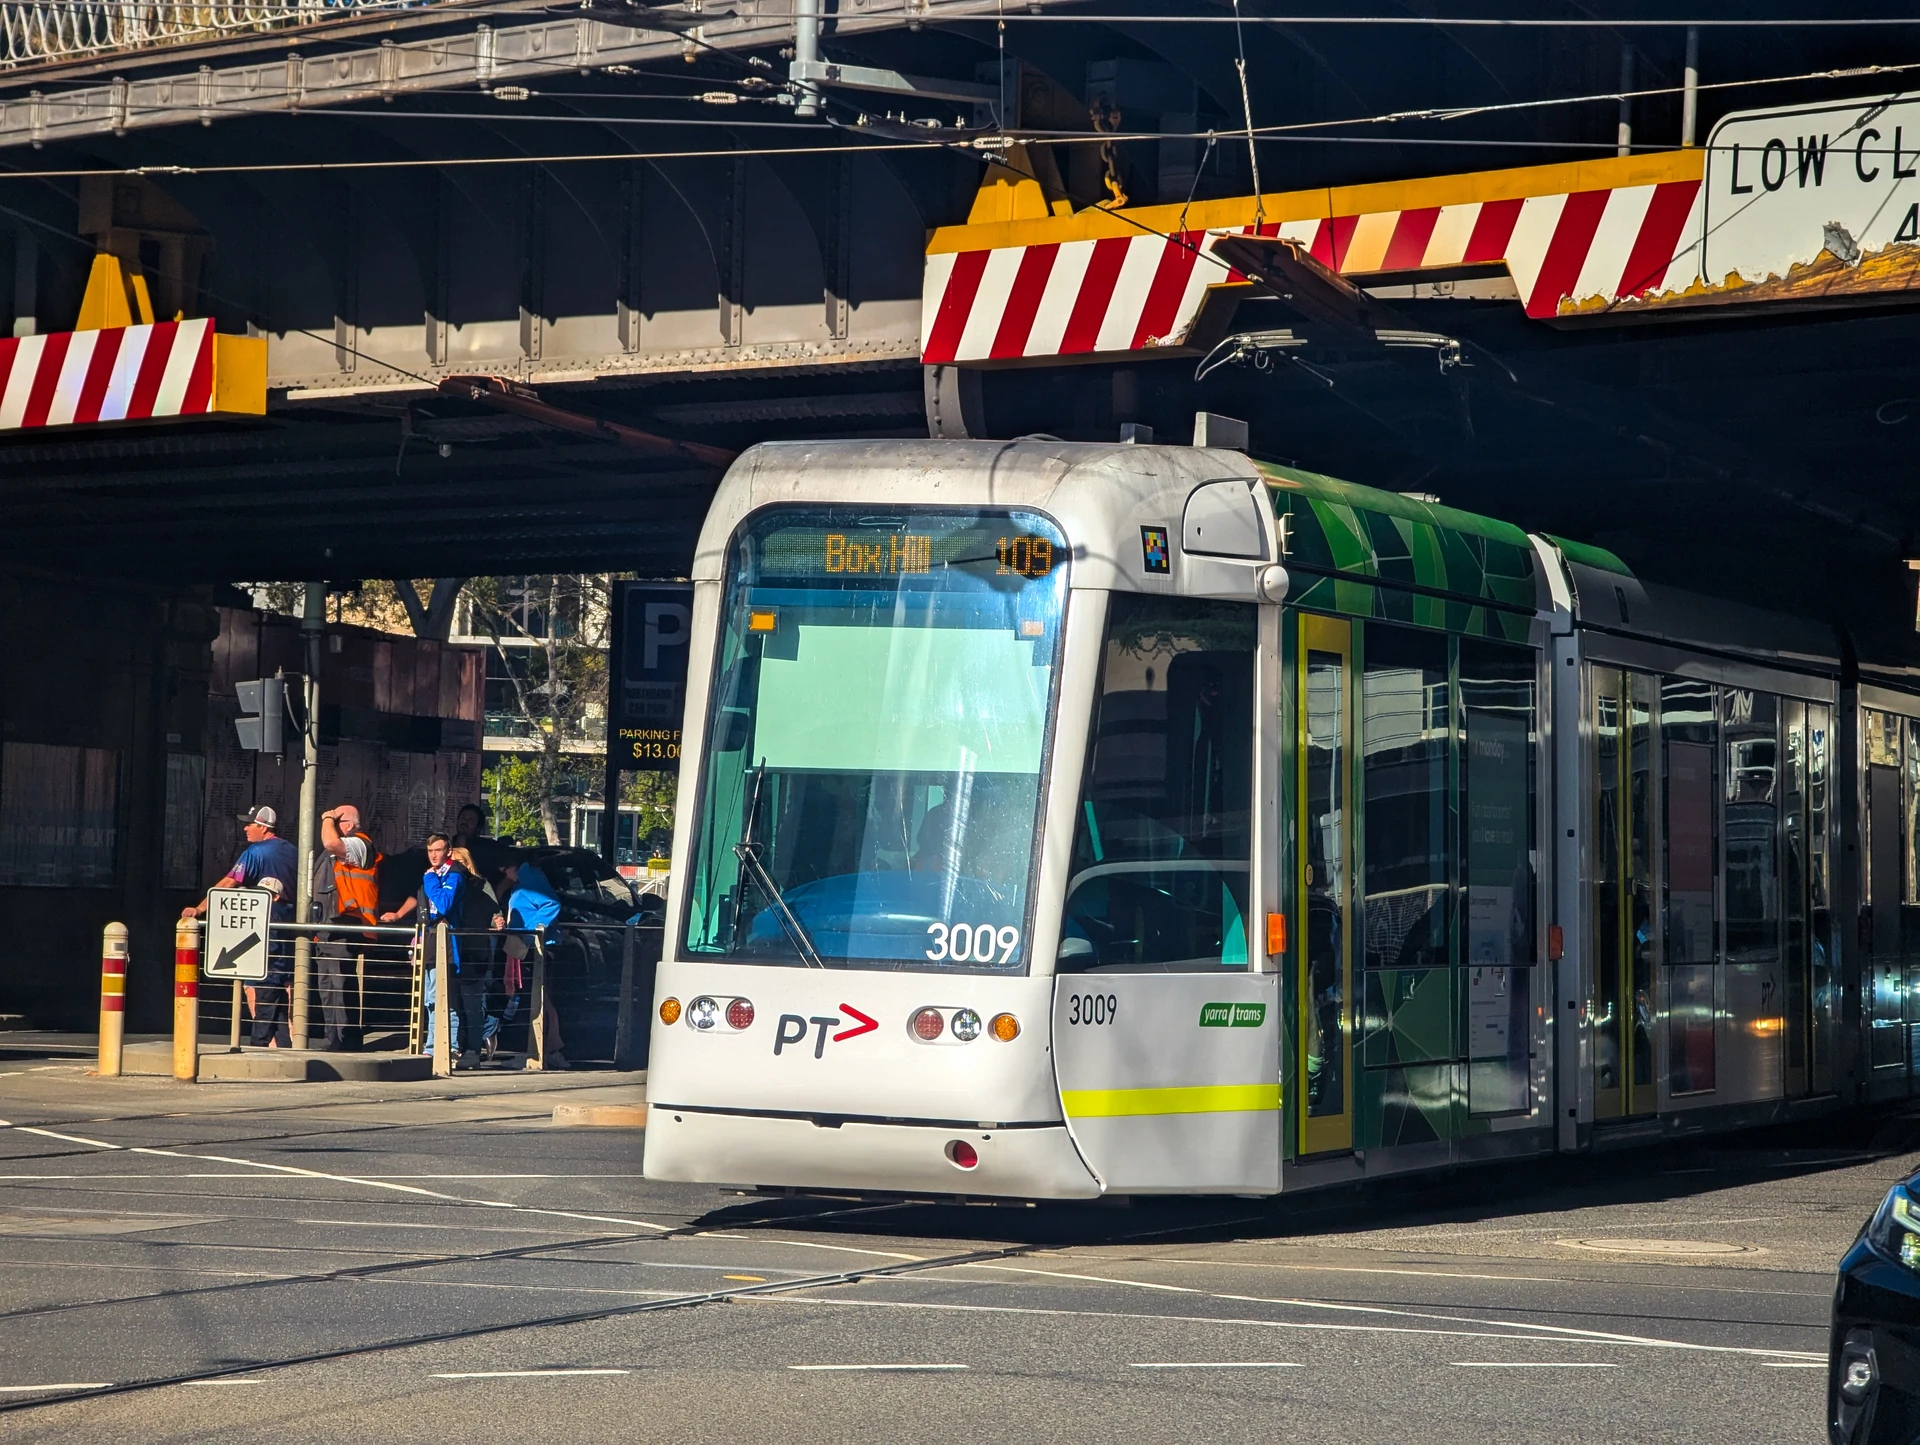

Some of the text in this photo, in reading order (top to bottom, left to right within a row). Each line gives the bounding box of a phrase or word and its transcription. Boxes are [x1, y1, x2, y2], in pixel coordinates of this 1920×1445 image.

[1731, 133, 1829, 195] LOW
[825, 534, 1053, 576] Box Hill 109
[643, 602, 691, 669] P
[619, 728, 671, 741] PARKING
[220, 897, 260, 912] KEEP
[220, 915, 257, 930] LEFT
[925, 922, 1020, 964] 3009
[1069, 994, 1118, 1026] 3009
[1204, 1007, 1262, 1024] yarra trams
